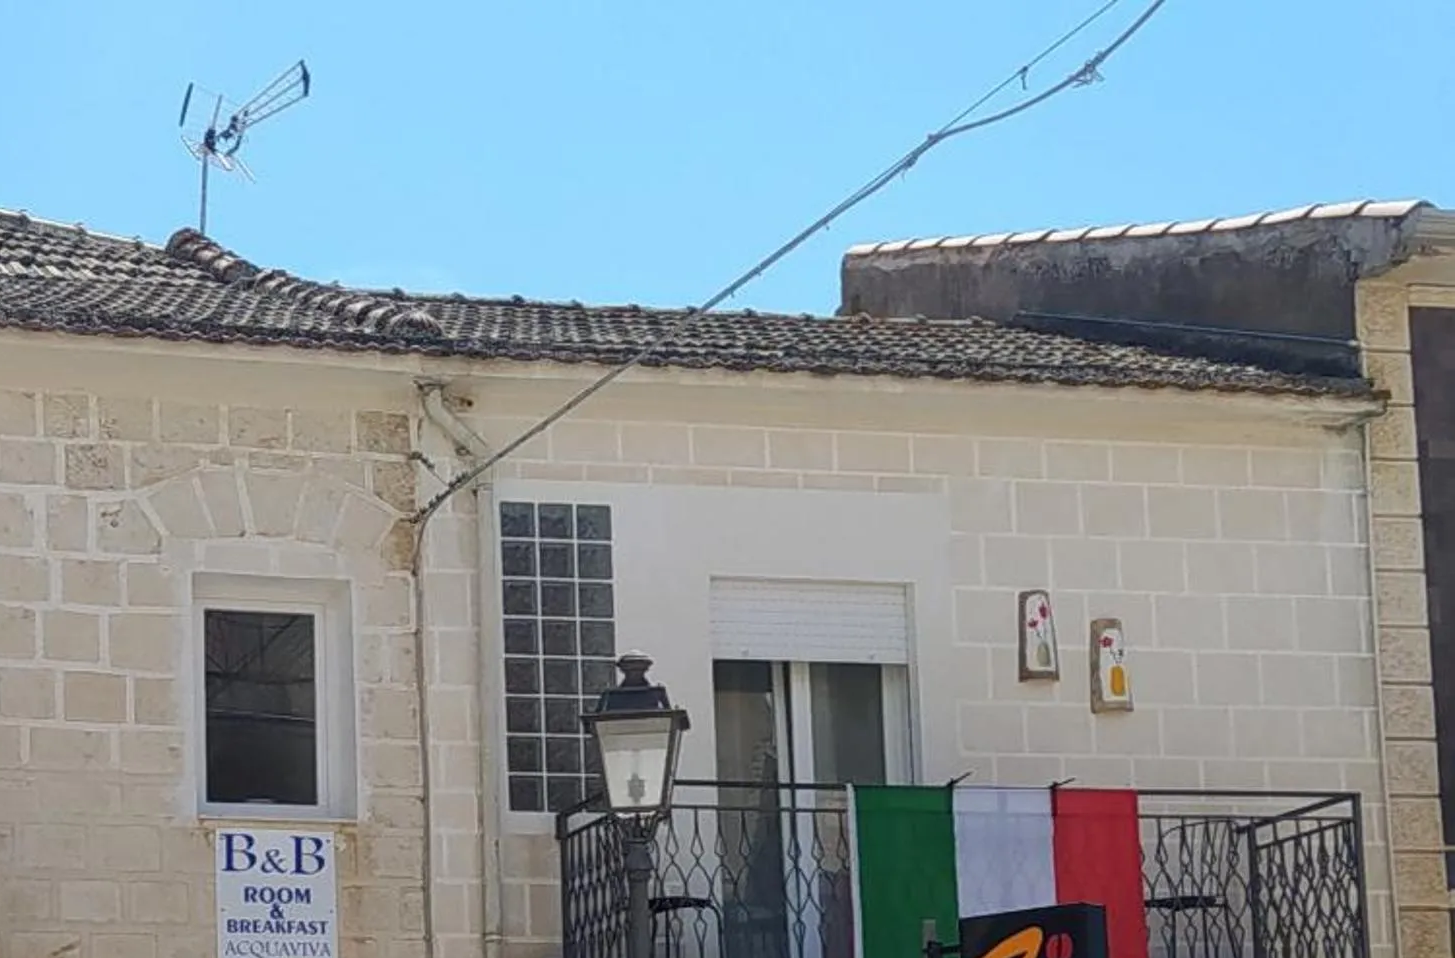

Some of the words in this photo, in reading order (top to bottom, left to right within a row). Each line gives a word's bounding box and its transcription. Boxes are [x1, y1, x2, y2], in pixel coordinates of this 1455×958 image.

[220, 833, 326, 875] B&B
[243, 886, 312, 904] ROOM
[269, 903, 285, 919] &
[226, 919, 329, 934] BREAKFAST
